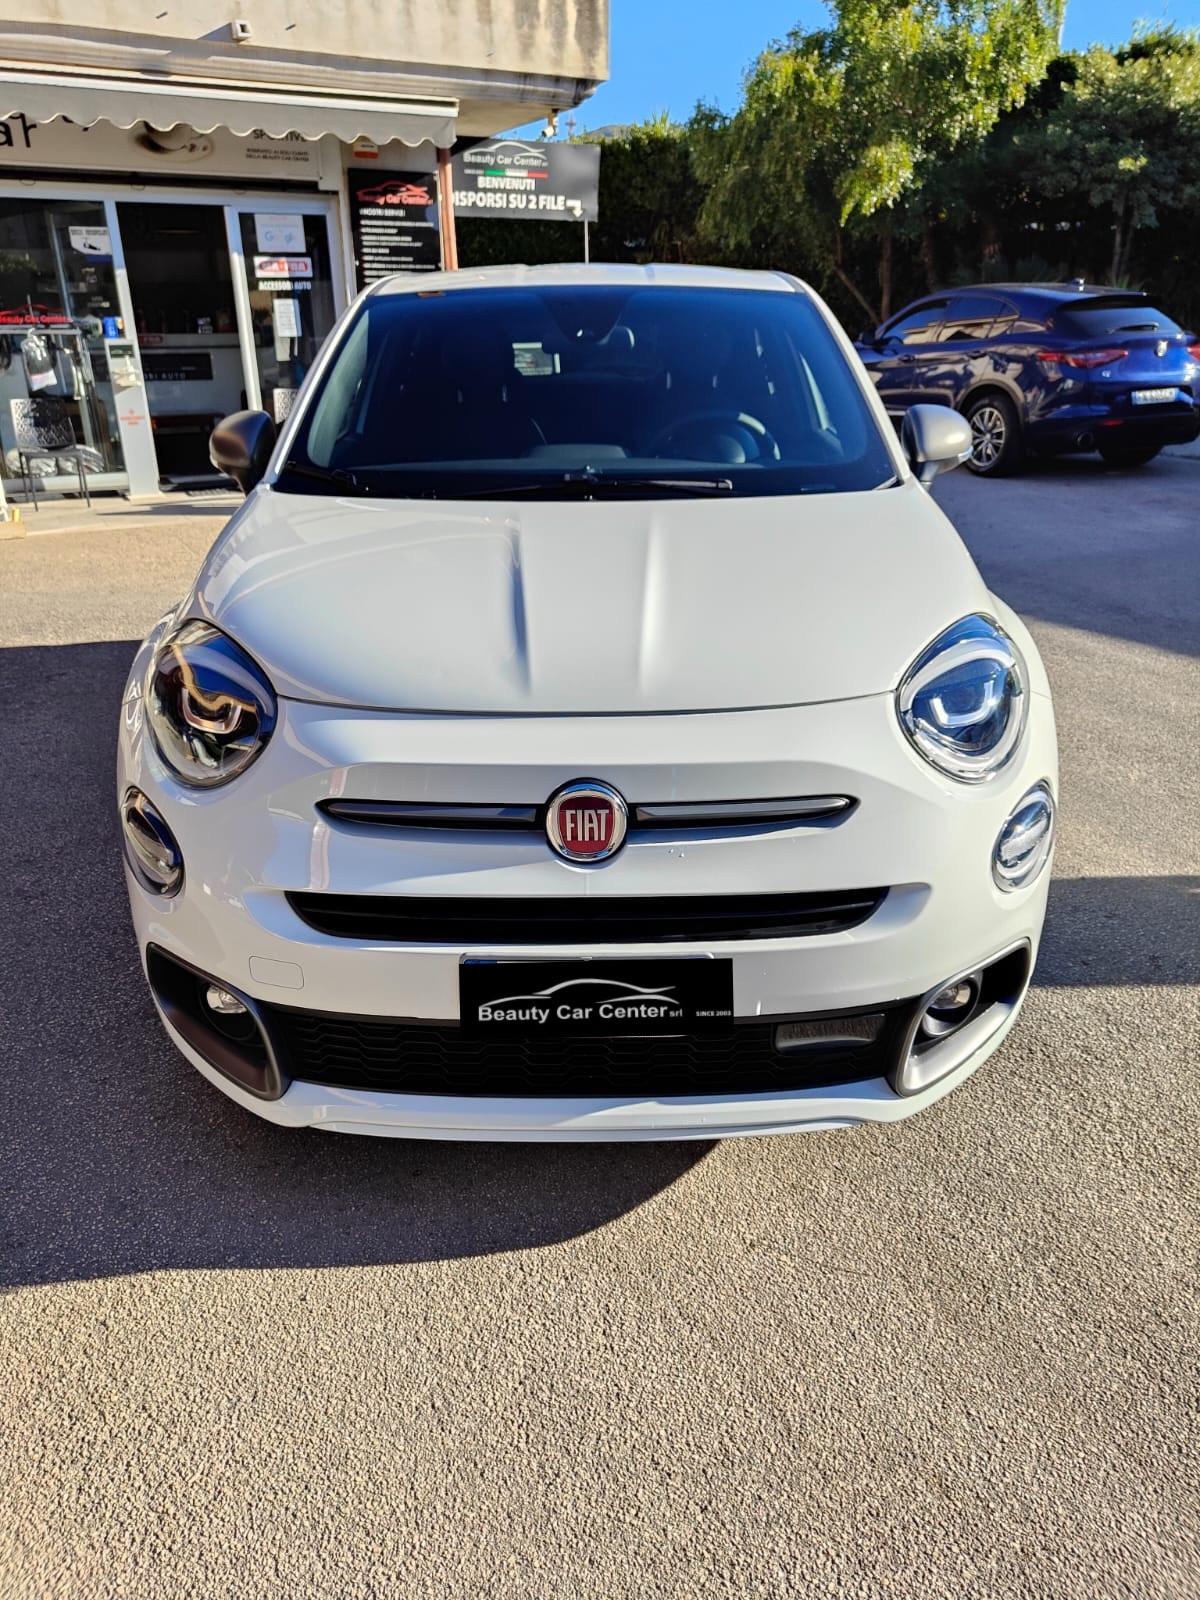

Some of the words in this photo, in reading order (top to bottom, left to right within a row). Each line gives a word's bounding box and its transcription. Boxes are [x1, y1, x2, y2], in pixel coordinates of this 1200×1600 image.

[463, 153, 495, 165] Beauty
[497, 155, 512, 165] Car
[514, 156, 542, 167] Center
[477, 176, 536, 190] BENVENUTI
[452, 190, 507, 208] ISPORSI
[508, 193, 526, 209] SU
[528, 195, 537, 209] 2
[539, 195, 565, 210] FILE
[565, 809, 609, 842] FIAT
